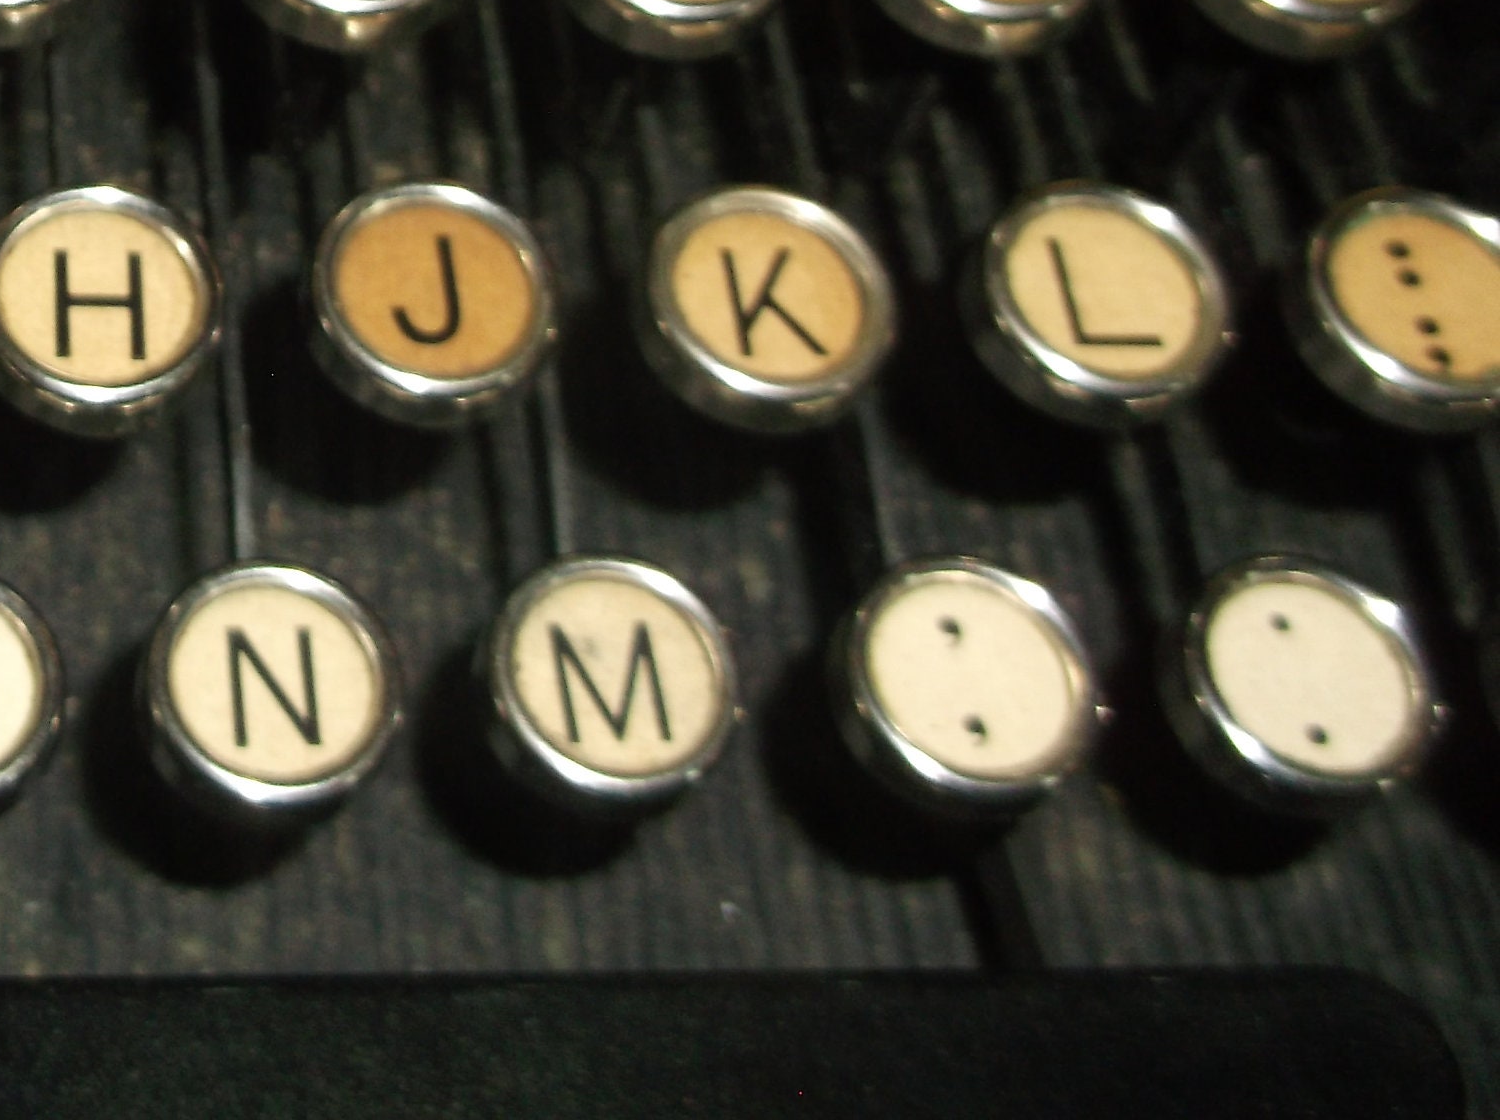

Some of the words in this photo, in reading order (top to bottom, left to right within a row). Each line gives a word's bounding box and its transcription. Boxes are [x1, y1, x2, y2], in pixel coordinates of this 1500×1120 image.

[54, 250, 146, 360] H
[392, 234, 462, 346] J
[720, 248, 830, 357] K
[1046, 237, 1164, 348] L
[227, 628, 322, 747] N
[549, 622, 672, 745] M
